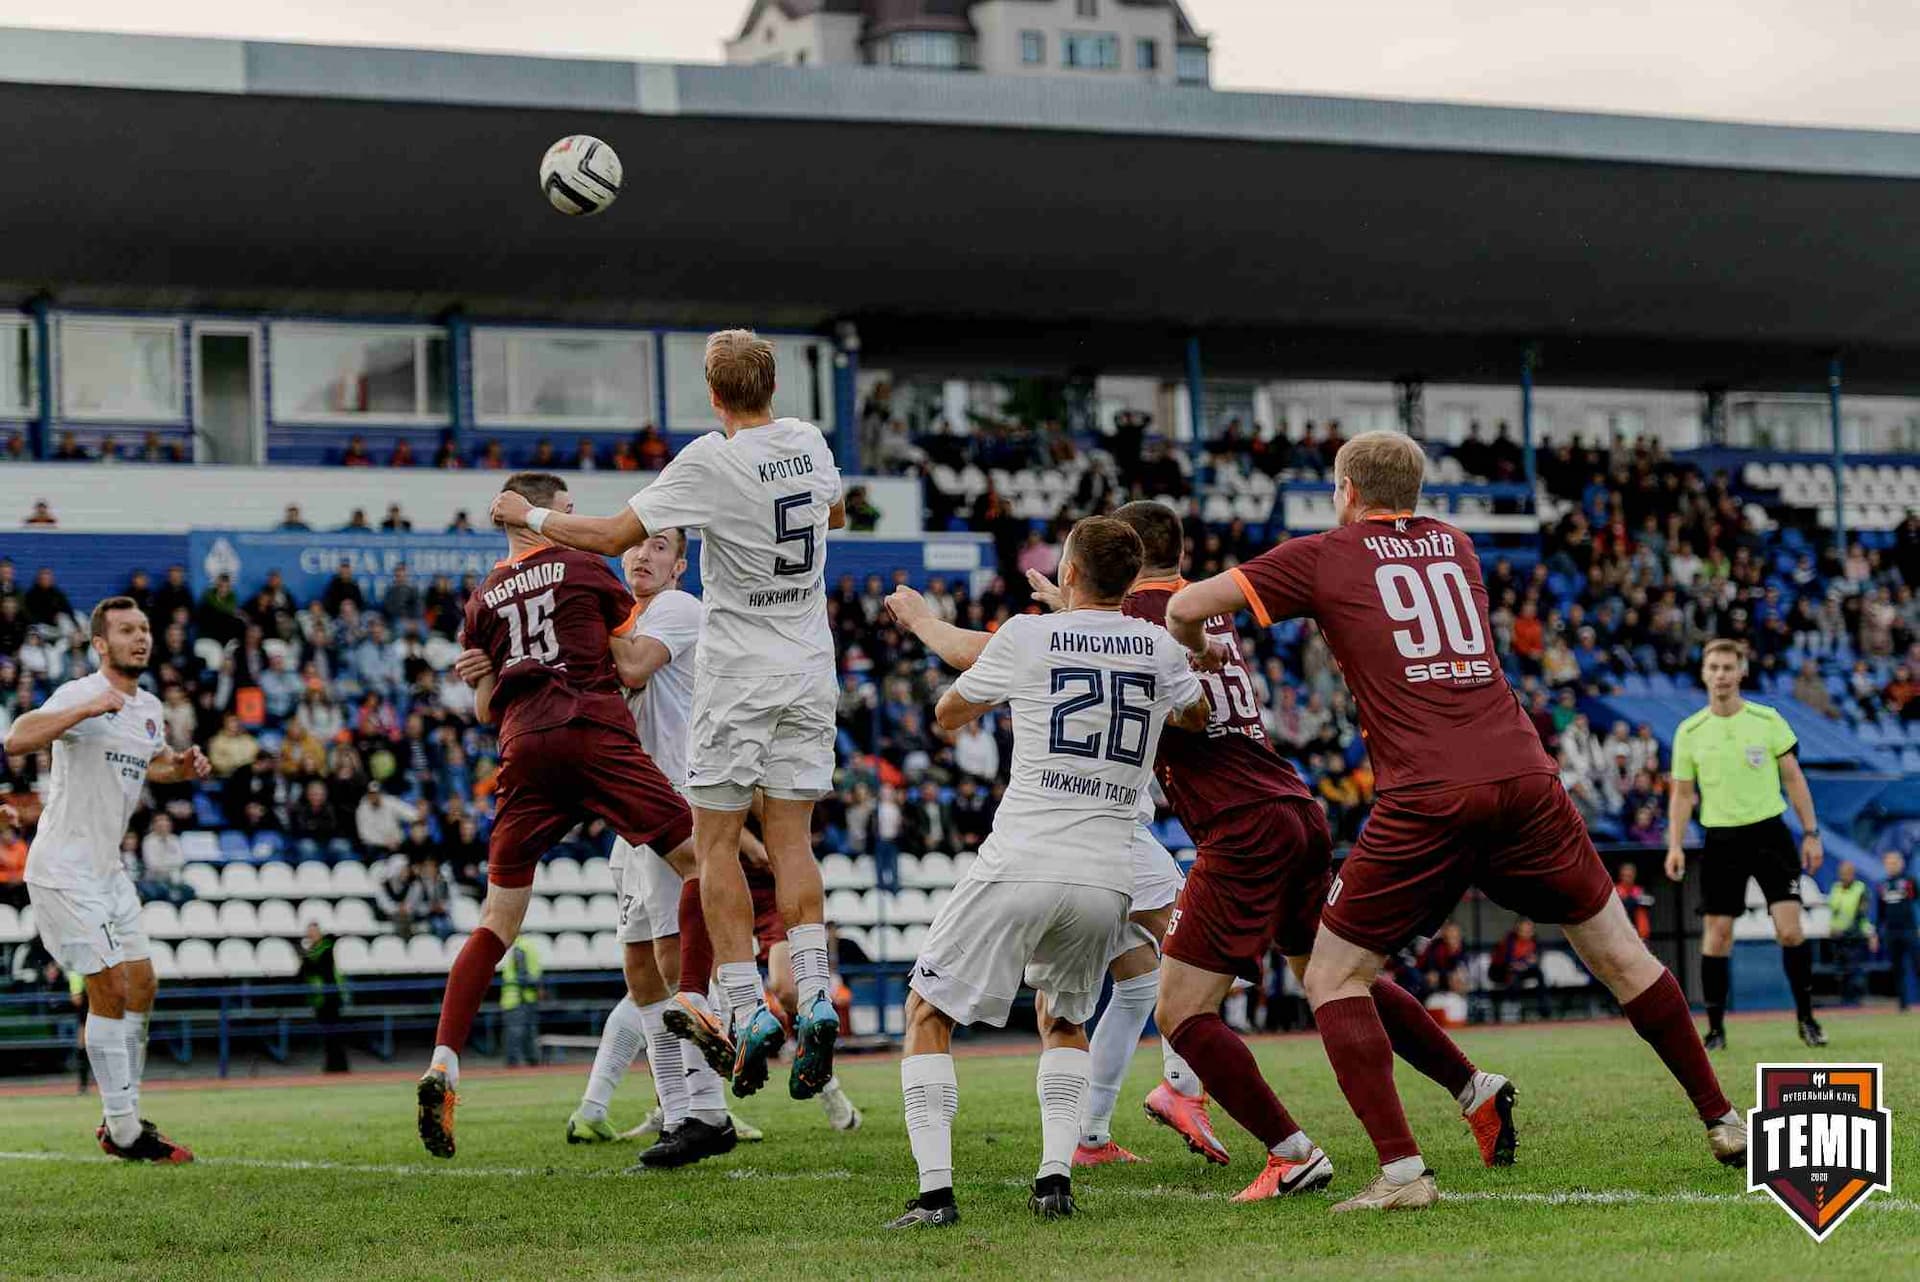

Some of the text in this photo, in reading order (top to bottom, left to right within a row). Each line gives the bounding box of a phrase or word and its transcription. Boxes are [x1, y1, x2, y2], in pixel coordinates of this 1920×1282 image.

[758, 454, 813, 483] КРОТОВ
[774, 491, 815, 576] 5
[1363, 529, 1456, 560] ЧЕВЕЛЁВ
[483, 562, 565, 609] АБРАМОВ
[497, 588, 560, 663] 15
[1374, 561, 1486, 659] 90
[1050, 631, 1155, 656] АНИСИМОВ
[1404, 660, 1492, 683] SEUS
[1049, 667, 1156, 768] 26
[1040, 769, 1101, 798] НИЖНИЙ
